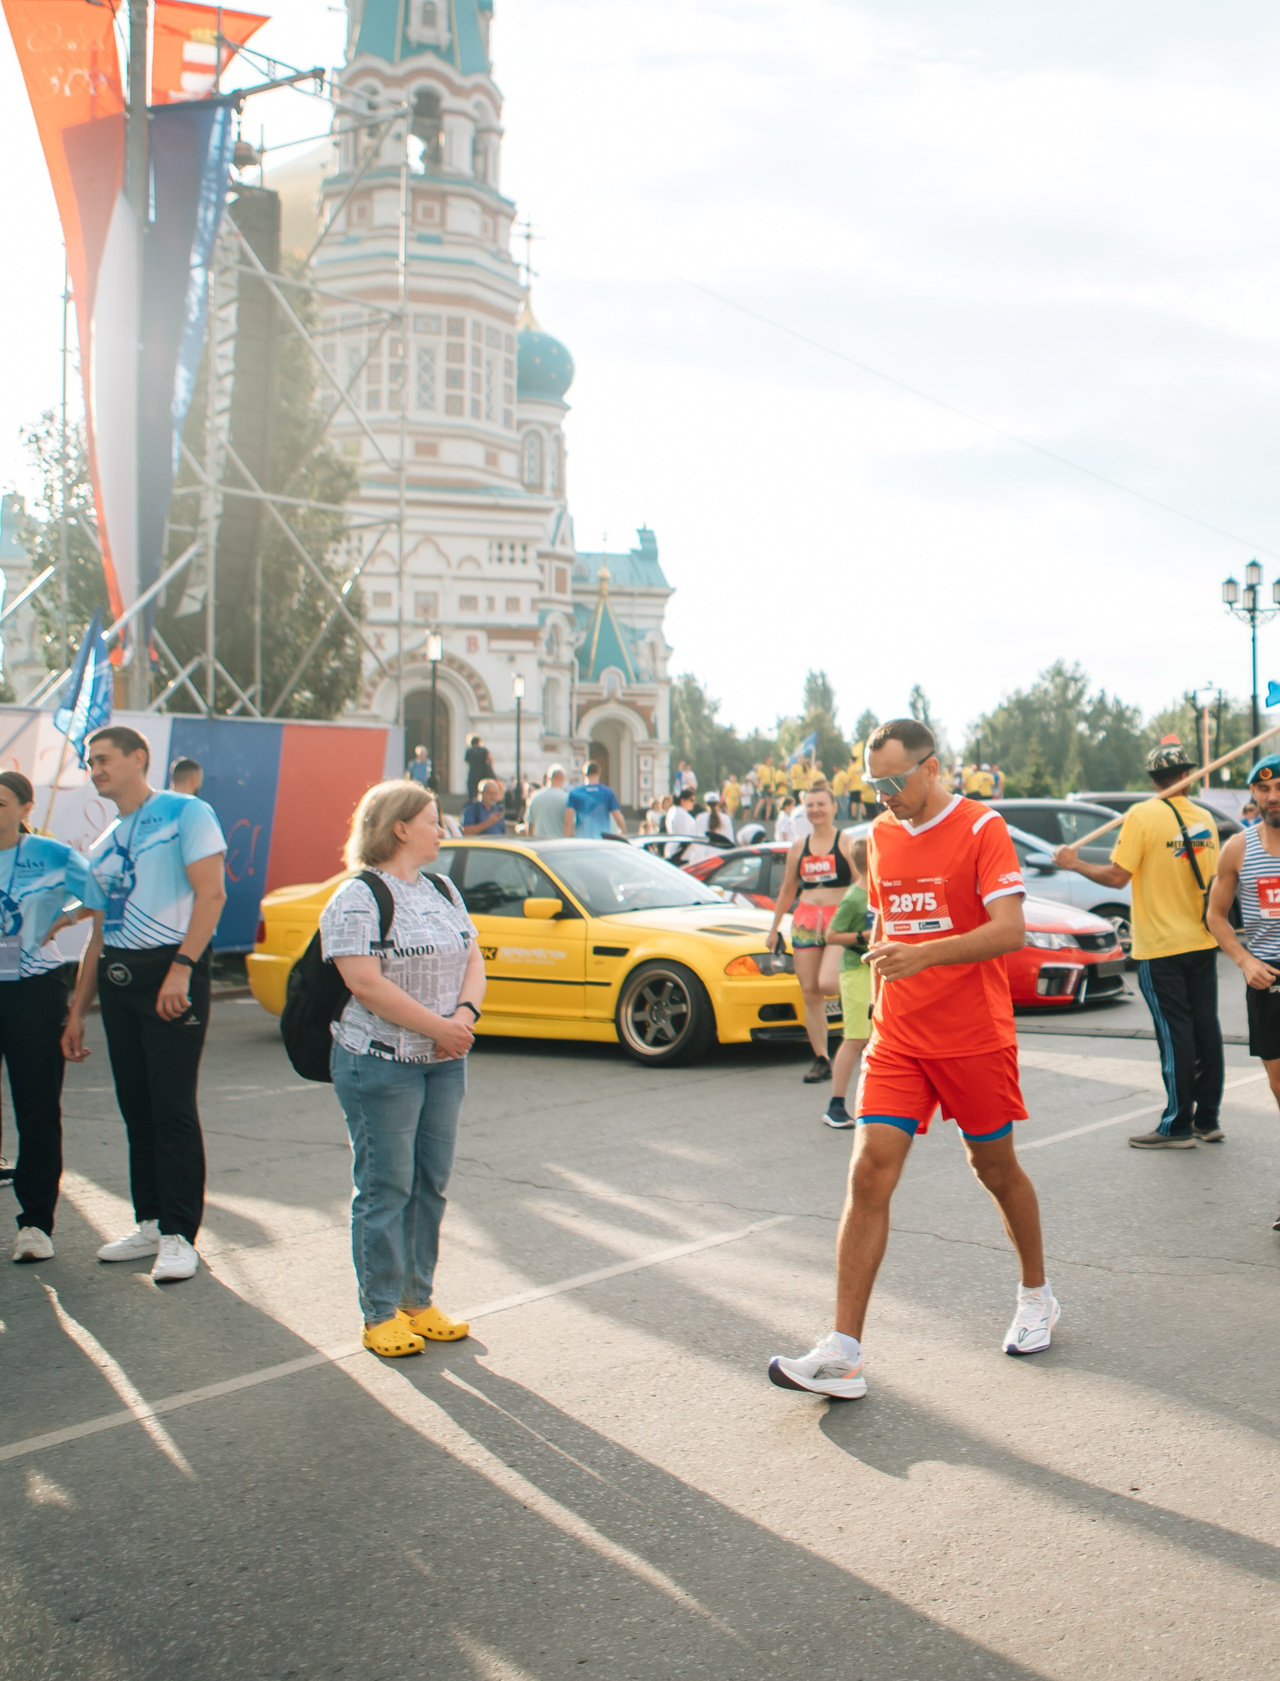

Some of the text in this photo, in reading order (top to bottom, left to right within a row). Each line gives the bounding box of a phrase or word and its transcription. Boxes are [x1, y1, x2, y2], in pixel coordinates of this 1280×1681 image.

[805, 861, 831, 873] 1908
[888, 892, 938, 913] 2875
[393, 944, 435, 958] MOOD
